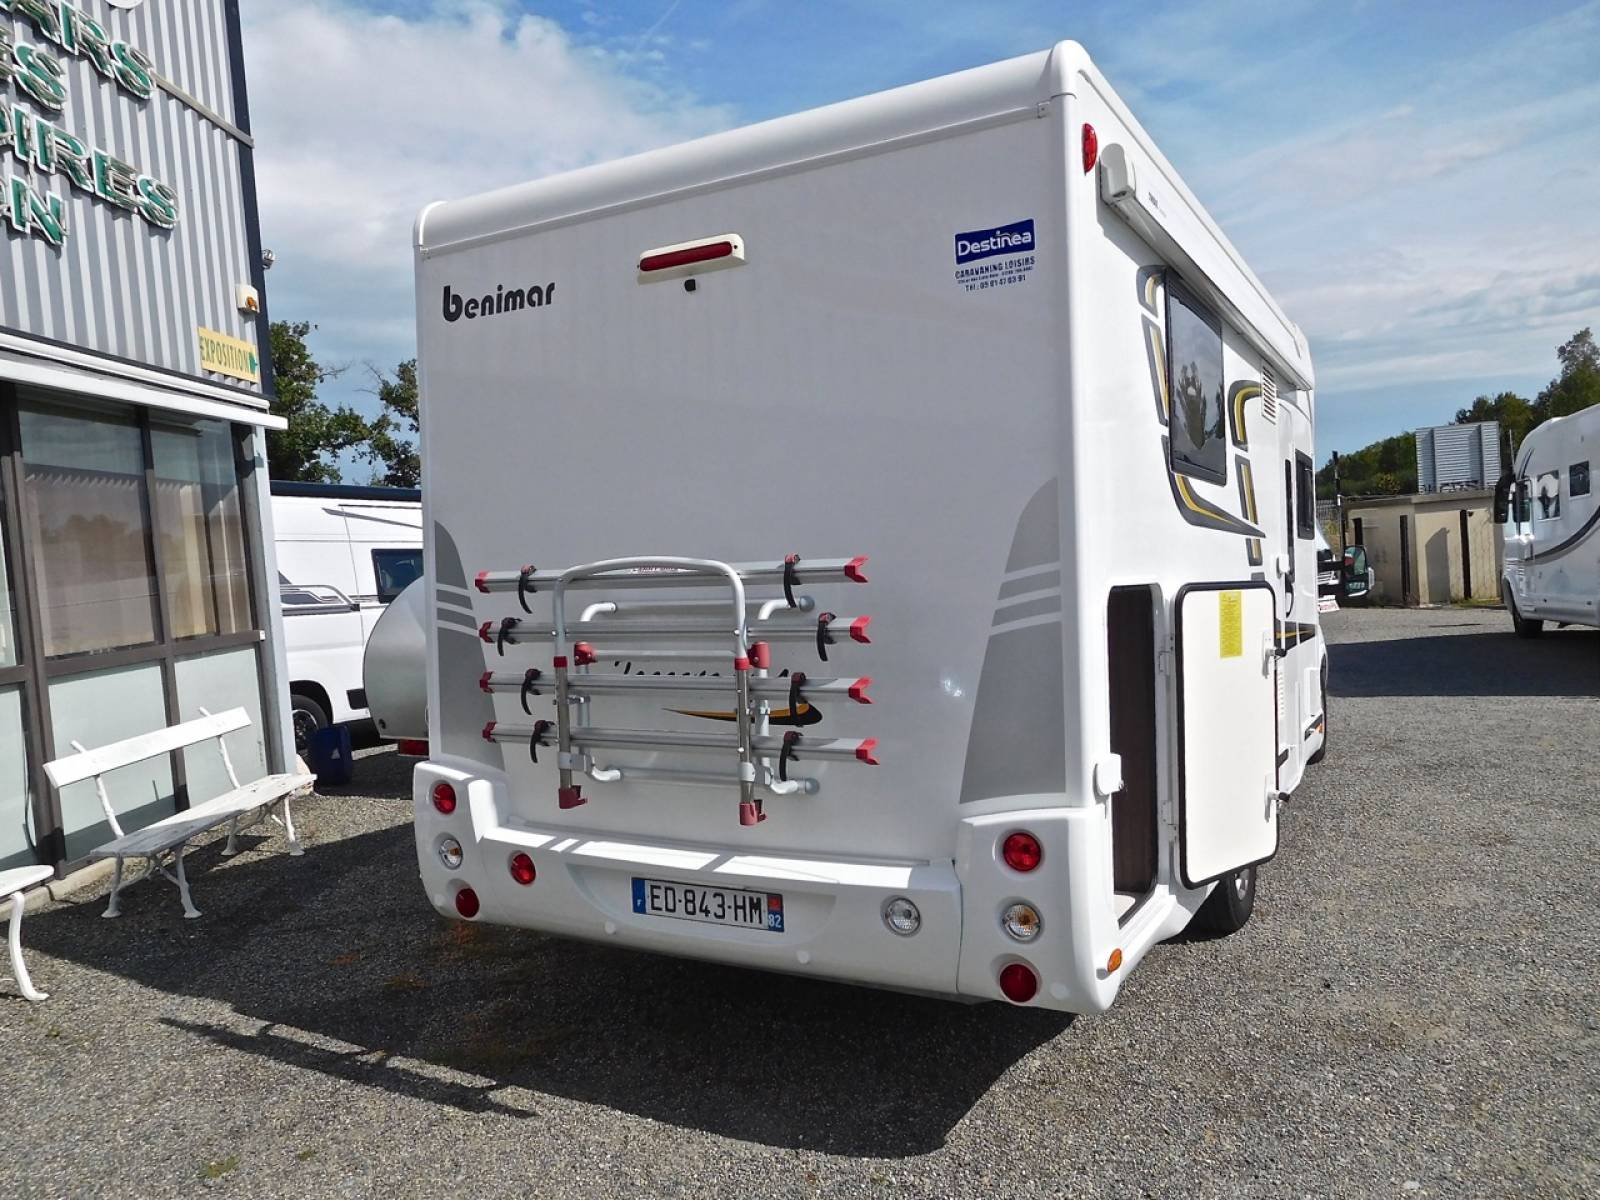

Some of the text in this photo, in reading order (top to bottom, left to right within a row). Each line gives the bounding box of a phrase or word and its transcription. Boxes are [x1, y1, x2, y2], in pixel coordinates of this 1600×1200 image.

[1005, 256, 1035, 270] LOISIRS
[443, 282, 555, 322] benimar
[200, 336, 250, 373] EXPOSITION
[768, 914, 782, 928] 82
